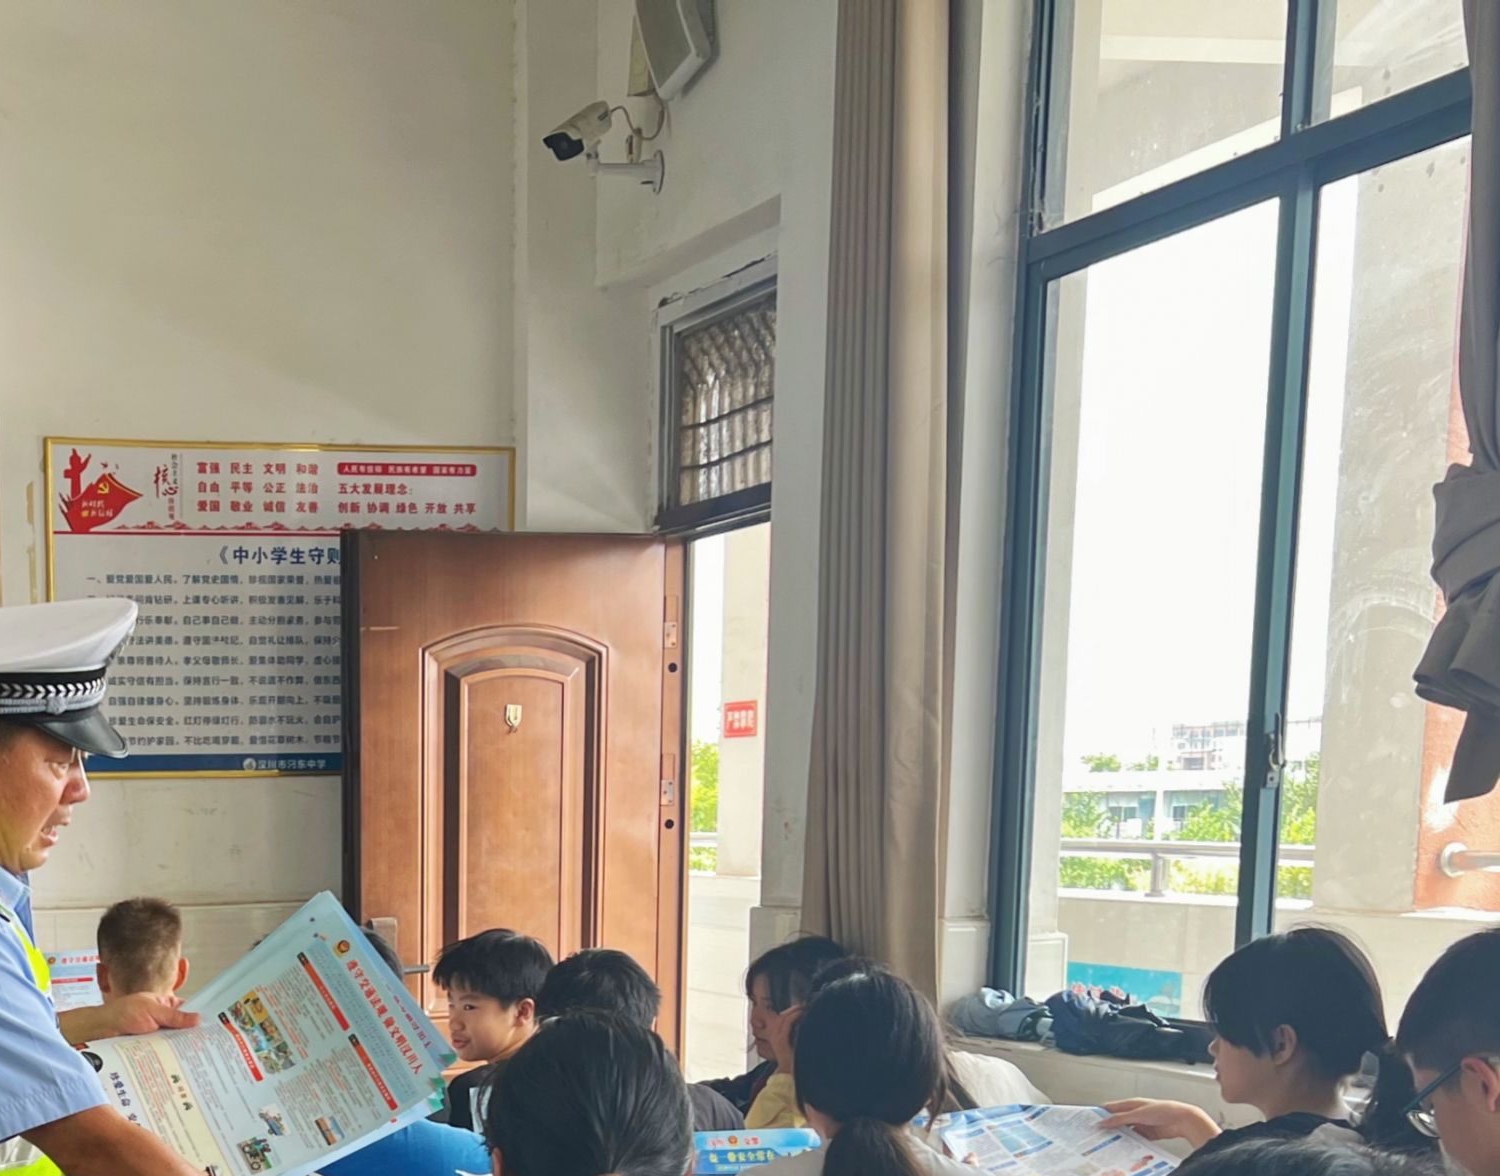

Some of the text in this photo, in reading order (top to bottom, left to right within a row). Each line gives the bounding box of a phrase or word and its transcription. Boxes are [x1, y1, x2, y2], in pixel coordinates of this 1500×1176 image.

[197, 462, 319, 475] 富强 民主 文明 和谐
[197, 481, 319, 494] 自由 平等 公正 法治
[197, 500, 319, 513] 爱国 敬业 诚信 友善
[338, 502, 360, 514] 创新
[425, 503, 447, 515] 开放
[453, 503, 476, 515] 共享
